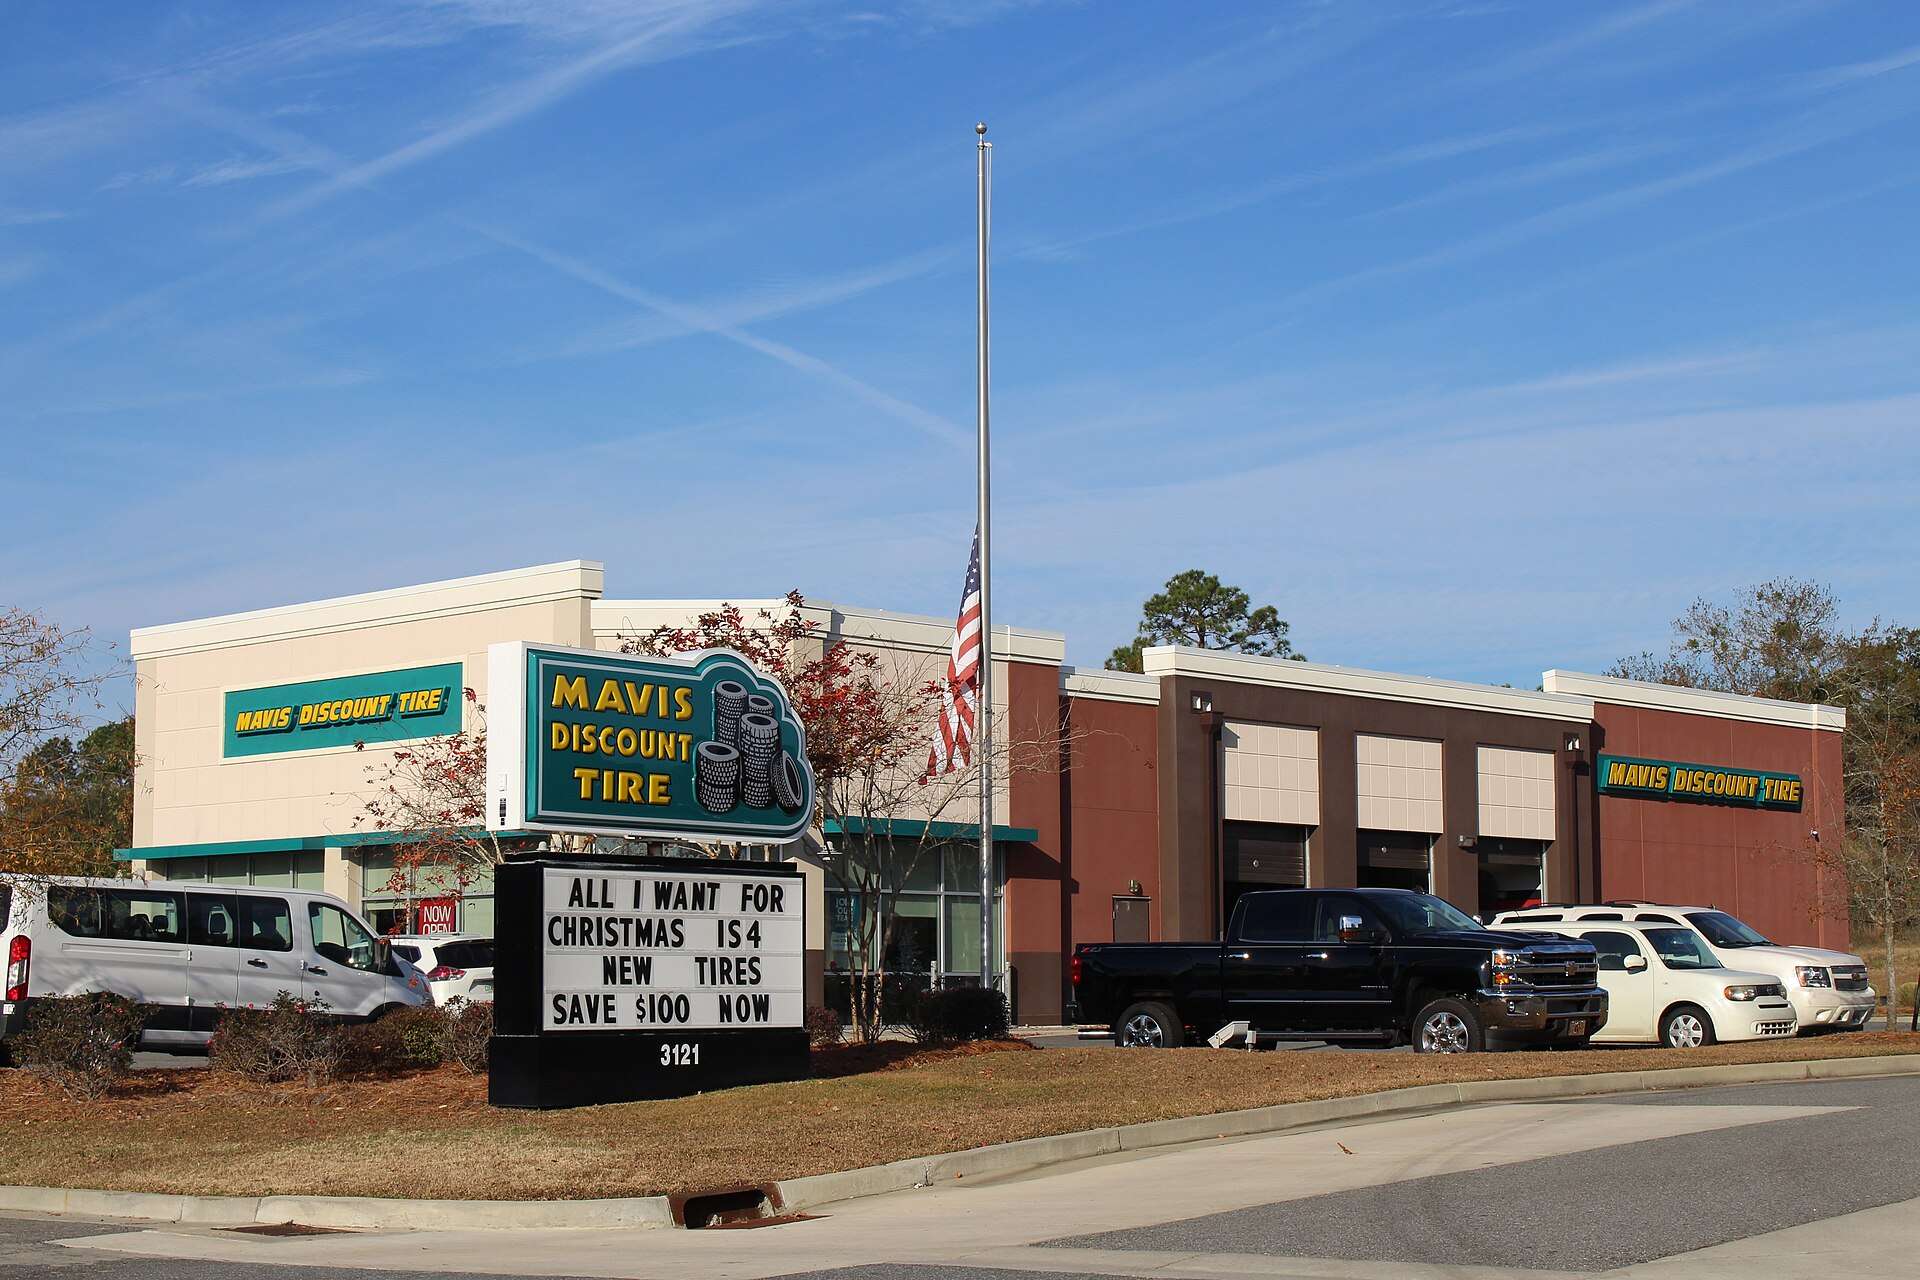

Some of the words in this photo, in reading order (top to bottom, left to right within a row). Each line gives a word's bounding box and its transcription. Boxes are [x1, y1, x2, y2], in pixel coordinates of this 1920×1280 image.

[235, 706, 292, 732] MAVIS
[299, 694, 391, 726] DISCOUNT
[398, 687, 444, 714] TIRE
[552, 674, 693, 721] MAVIS
[552, 722, 693, 762] DISCOUNT
[574, 767, 672, 805] TIRE
[1608, 762, 1668, 789] MAVIS
[1673, 769, 1759, 798] DISCOUNT
[1764, 778, 1801, 801] TIRE
[568, 877, 614, 909] ALL
[633, 879, 641, 909] I
[654, 881, 720, 910] WANT
[741, 884, 784, 913] FOR
[423, 905, 451, 922] NOW
[548, 915, 684, 948] CHRISTMAS
[603, 956, 652, 985] NEW
[694, 956, 761, 986] TIRES
[552, 994, 617, 1025] SAVE
[636, 994, 690, 1024] $100
[719, 994, 769, 1023] NOW
[660, 1043, 699, 1066] 3121
